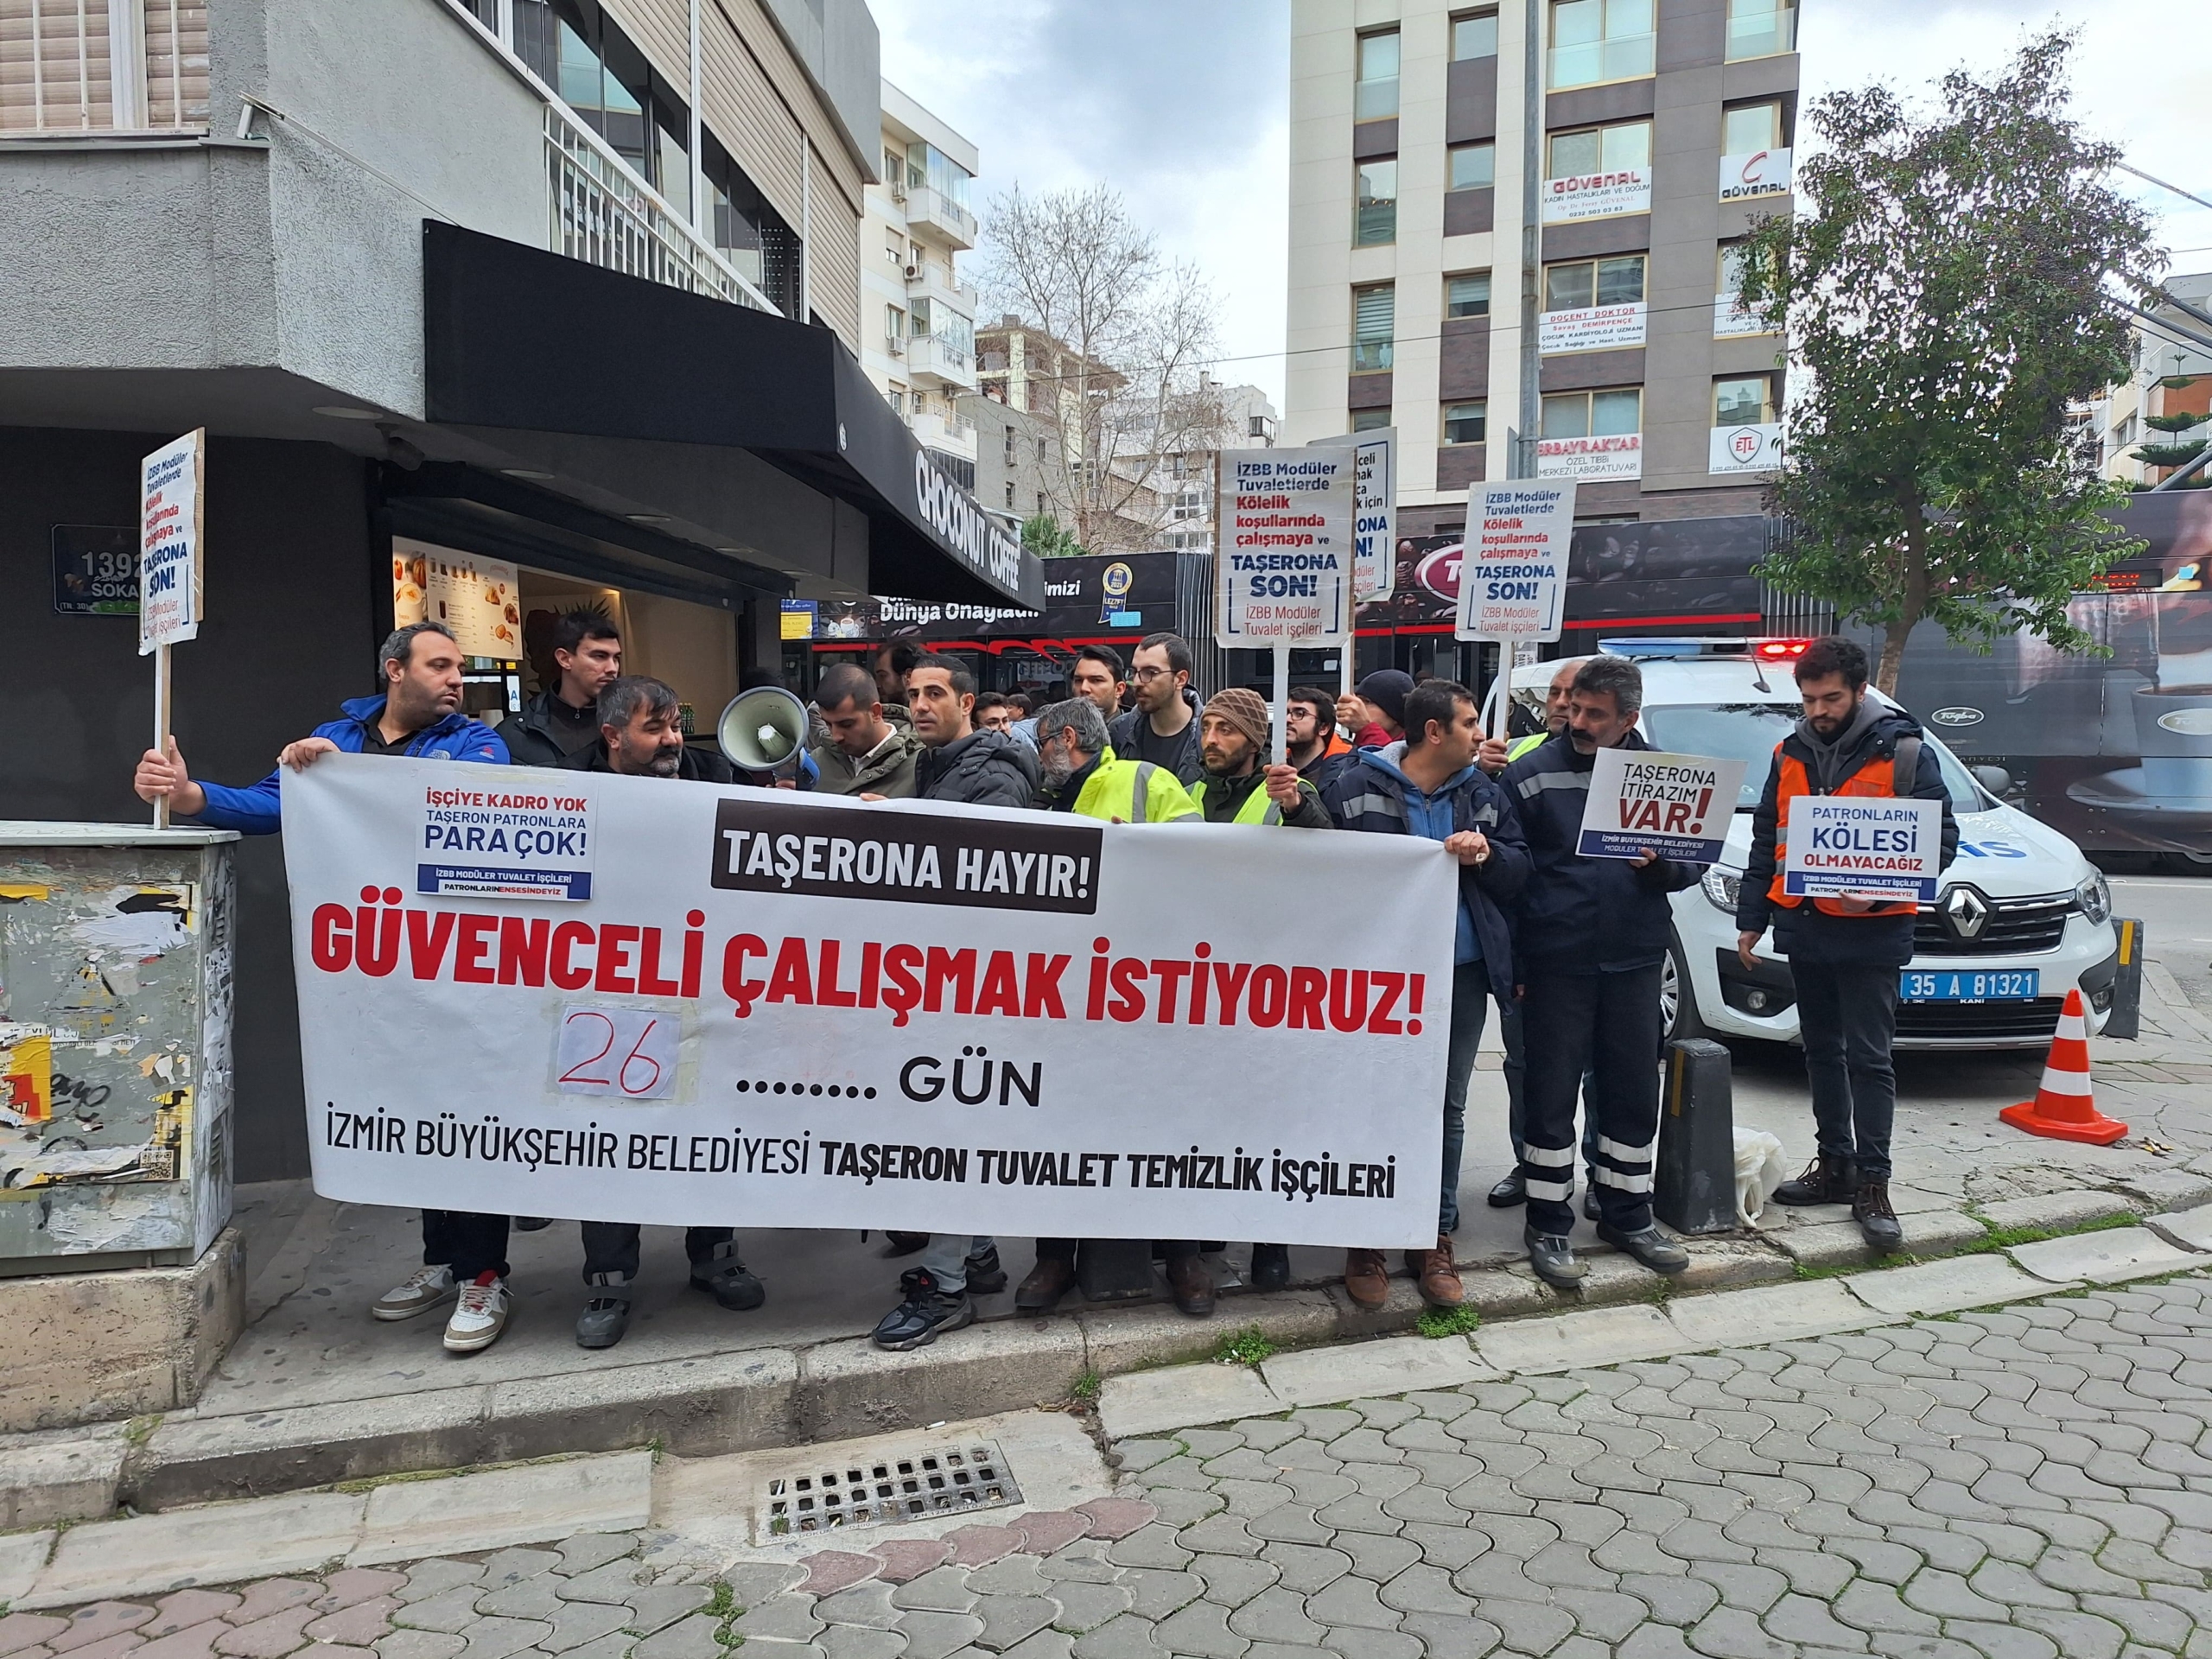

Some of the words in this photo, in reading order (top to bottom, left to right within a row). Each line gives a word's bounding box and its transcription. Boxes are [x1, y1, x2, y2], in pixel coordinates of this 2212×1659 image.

[1544, 195, 1564, 204] KADIN
[1567, 188, 1611, 200] HASTALIKLARI
[1550, 312, 1588, 323] DOÇENT
[1594, 307, 1636, 317] DOKTOR
[1582, 317, 1633, 328] DEMİRPENÇE
[1541, 334, 1565, 342] ÇOCUK
[1617, 325, 1643, 334] UZMANI
[1735, 436, 1755, 454] ETL
[161, 452, 188, 472] Modüler
[1357, 452, 1376, 466] celi
[1237, 461, 1272, 476] İZBB
[1276, 462, 1337, 475] Modüler
[1236, 477, 1330, 492] Tuvaletlerde
[1236, 495, 1290, 510] Kölelik
[1365, 496, 1383, 510] için
[1486, 492, 1511, 504] İZBB
[1515, 490, 1561, 503] Modüler
[1485, 503, 1554, 516] Tuvaletlerde
[175, 524, 183, 533] ve
[915, 449, 986, 569] CHOCONUT
[989, 526, 1021, 592] COFFEE
[1236, 514, 1325, 530] koşullarında
[1483, 518, 1523, 531] Kölelik
[1236, 531, 1313, 548] çalışmaya
[1318, 537, 1330, 545] ve
[1355, 537, 1374, 558] N!
[1481, 532, 1548, 546] koşullarında
[144, 542, 188, 575] TAŞERONA
[1480, 548, 1538, 561] çalışmaya
[1230, 554, 1338, 573] TAŞERONA
[1475, 565, 1555, 581] TAŞERONA
[92, 582, 139, 598] SOKA
[149, 566, 176, 598] SON!
[1249, 575, 1318, 597] SON!
[1486, 582, 1539, 601] SON!
[880, 601, 941, 625] Dünya
[1246, 604, 1272, 619] İZBB
[1275, 606, 1321, 620] Modüler
[1482, 605, 1501, 618] İZBB
[1503, 606, 1540, 618] Modüler
[1244, 622, 1283, 635] Tuvalet
[1287, 622, 1323, 639] işçileri
[1479, 620, 1509, 632] Tuvalet
[1510, 620, 1540, 634] işçileri
[1624, 763, 1715, 786] TAŞERONA
[426, 786, 483, 809] İŞÇİYE
[487, 793, 549, 810] KADRO
[553, 797, 588, 812] YOK
[1620, 779, 1698, 803] İTİRAZIM
[426, 810, 490, 825] TAŞERON
[493, 813, 587, 830] PATRONLARA
[1619, 788, 1713, 835] VAR!
[1813, 807, 1918, 823] PATRONLARIN
[425, 824, 509, 853] PARA
[514, 829, 587, 859] ÇOK!
[1601, 834, 1620, 843] İZMİR
[1663, 837, 1705, 849] BELEDİYESİ
[1813, 822, 1917, 853] KÖLESİ
[1669, 848, 1697, 857] İŞÇİLERİ
[722, 829, 942, 889] TAŞERONA
[956, 847, 1090, 899] HAYIR!
[1804, 854, 1923, 871] OLMAYACAĞIZ
[435, 868, 454, 879] İZBB
[455, 869, 496, 880] MODÜLER
[498, 872, 536, 883] TUVALET
[537, 873, 572, 884] İŞÇİLERİ
[1821, 875, 1857, 885] MODÜLER
[1892, 878, 1923, 887] İŞÇİLERİ
[311, 885, 707, 999] GÜVENCELİ
[721, 933, 1072, 1028] ÇALIŞMAK
[1085, 936, 1427, 1037] İSTİYORUZ!
[1910, 974, 1936, 996] 35
[1948, 975, 1961, 996] A
[1974, 973, 2033, 996] 81321
[557, 1010, 663, 1095] 26
[899, 1045, 1042, 1108] GÜN
[327, 1101, 406, 1155] İZMİR
[416, 1111, 619, 1173] BÜYÜKŞEHİR
[628, 1127, 810, 1176] BELEDİYESİ
[820, 1141, 967, 1186] TAŞERON
[976, 1148, 1119, 1188] TUVALET
[1127, 1145, 1263, 1192] TEMİZLİK
[1271, 1147, 1396, 1203] İŞÇİLERİ
